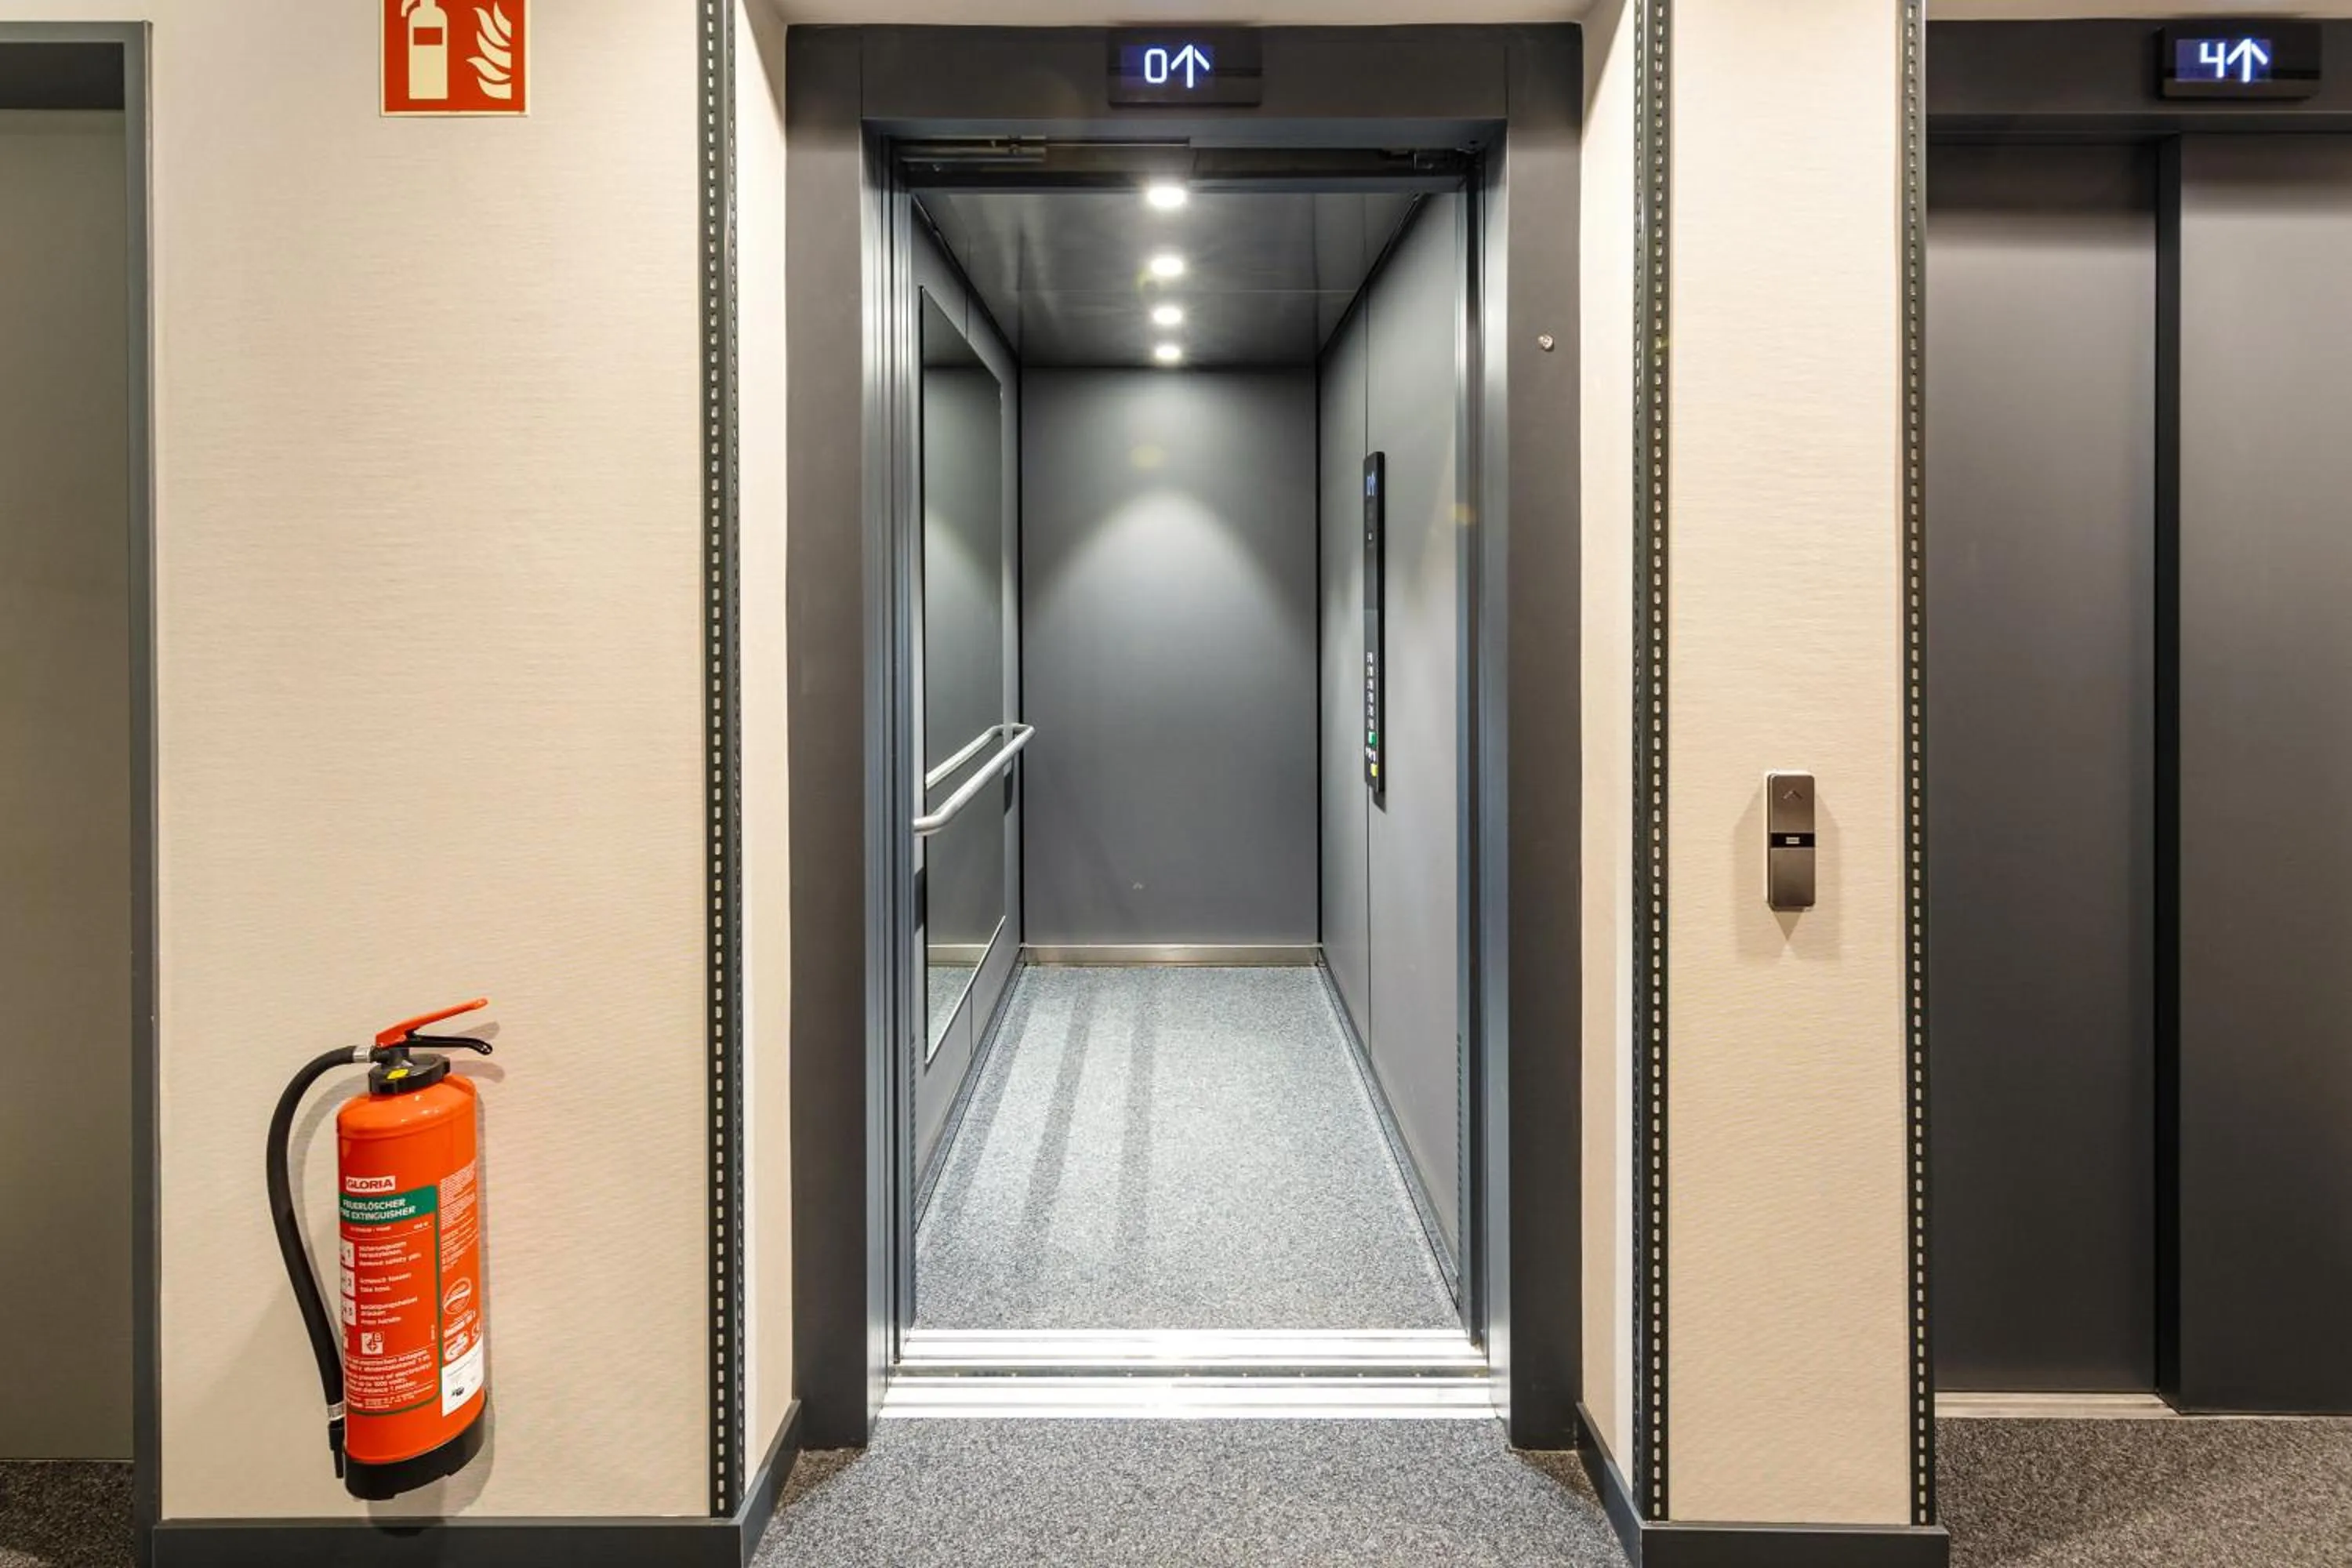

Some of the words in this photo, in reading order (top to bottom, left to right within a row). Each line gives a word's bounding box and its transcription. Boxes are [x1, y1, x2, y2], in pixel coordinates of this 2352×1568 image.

[2200, 42, 2225, 78] 4
[347, 1178, 393, 1190] GLORIA
[350, 1205, 416, 1221] EXTINGUISHER
